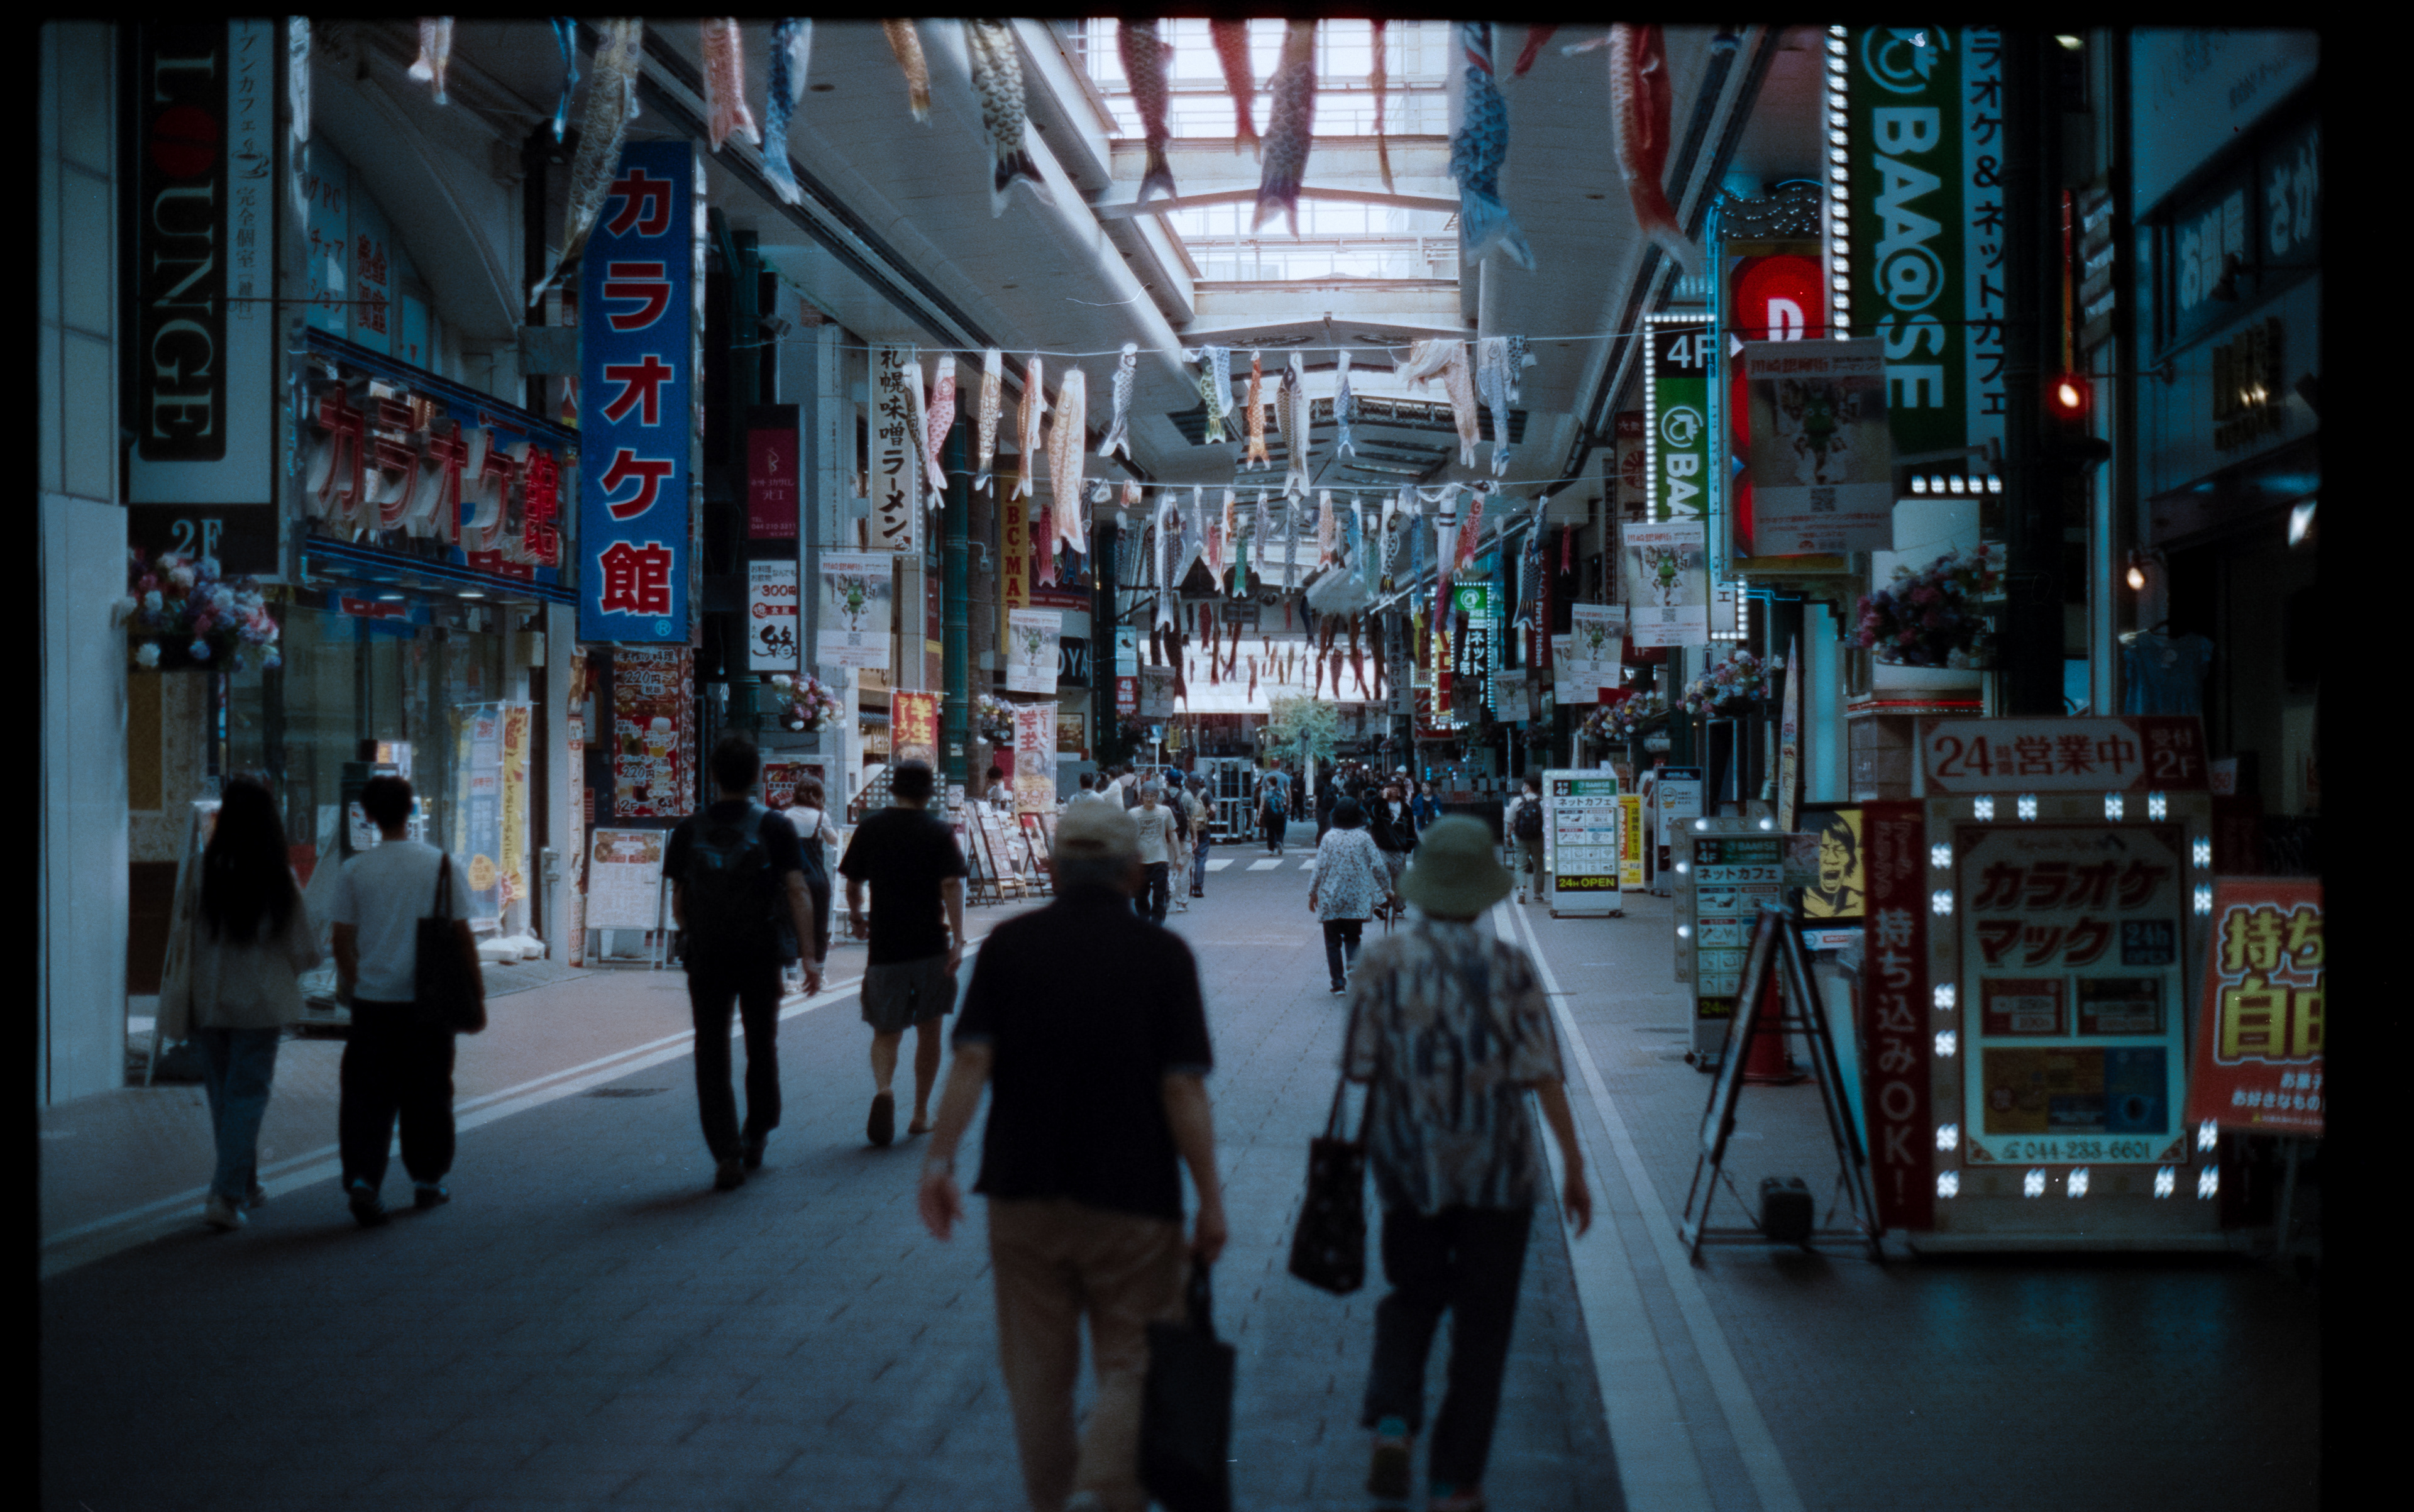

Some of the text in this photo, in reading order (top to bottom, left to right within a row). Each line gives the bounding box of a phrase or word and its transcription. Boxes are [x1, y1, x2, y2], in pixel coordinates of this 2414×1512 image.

[1970, 25, 2005, 416] ラオケ&ネットカフェ
[1667, 334, 1714, 369] 4F
[597, 167, 675, 617] カラオケ館
[878, 345, 907, 539] 札幌味噌ラーメン
[1535, 601, 1543, 667] First Kitchen
[897, 696, 910, 742] ラーメン
[910, 697, 932, 744] 学生
[2154, 751, 2197, 779] 2F
[1558, 798, 1611, 806] ネットカフェ
[1697, 851, 1717, 863] 4F
[1699, 867, 1777, 880] ネットカフェ
[1580, 878, 1615, 887] OPEN
[1972, 861, 2171, 911] カラオケ
[1975, 918, 2113, 968] マック
[2231, 1087, 2325, 1111] お好きなもの
